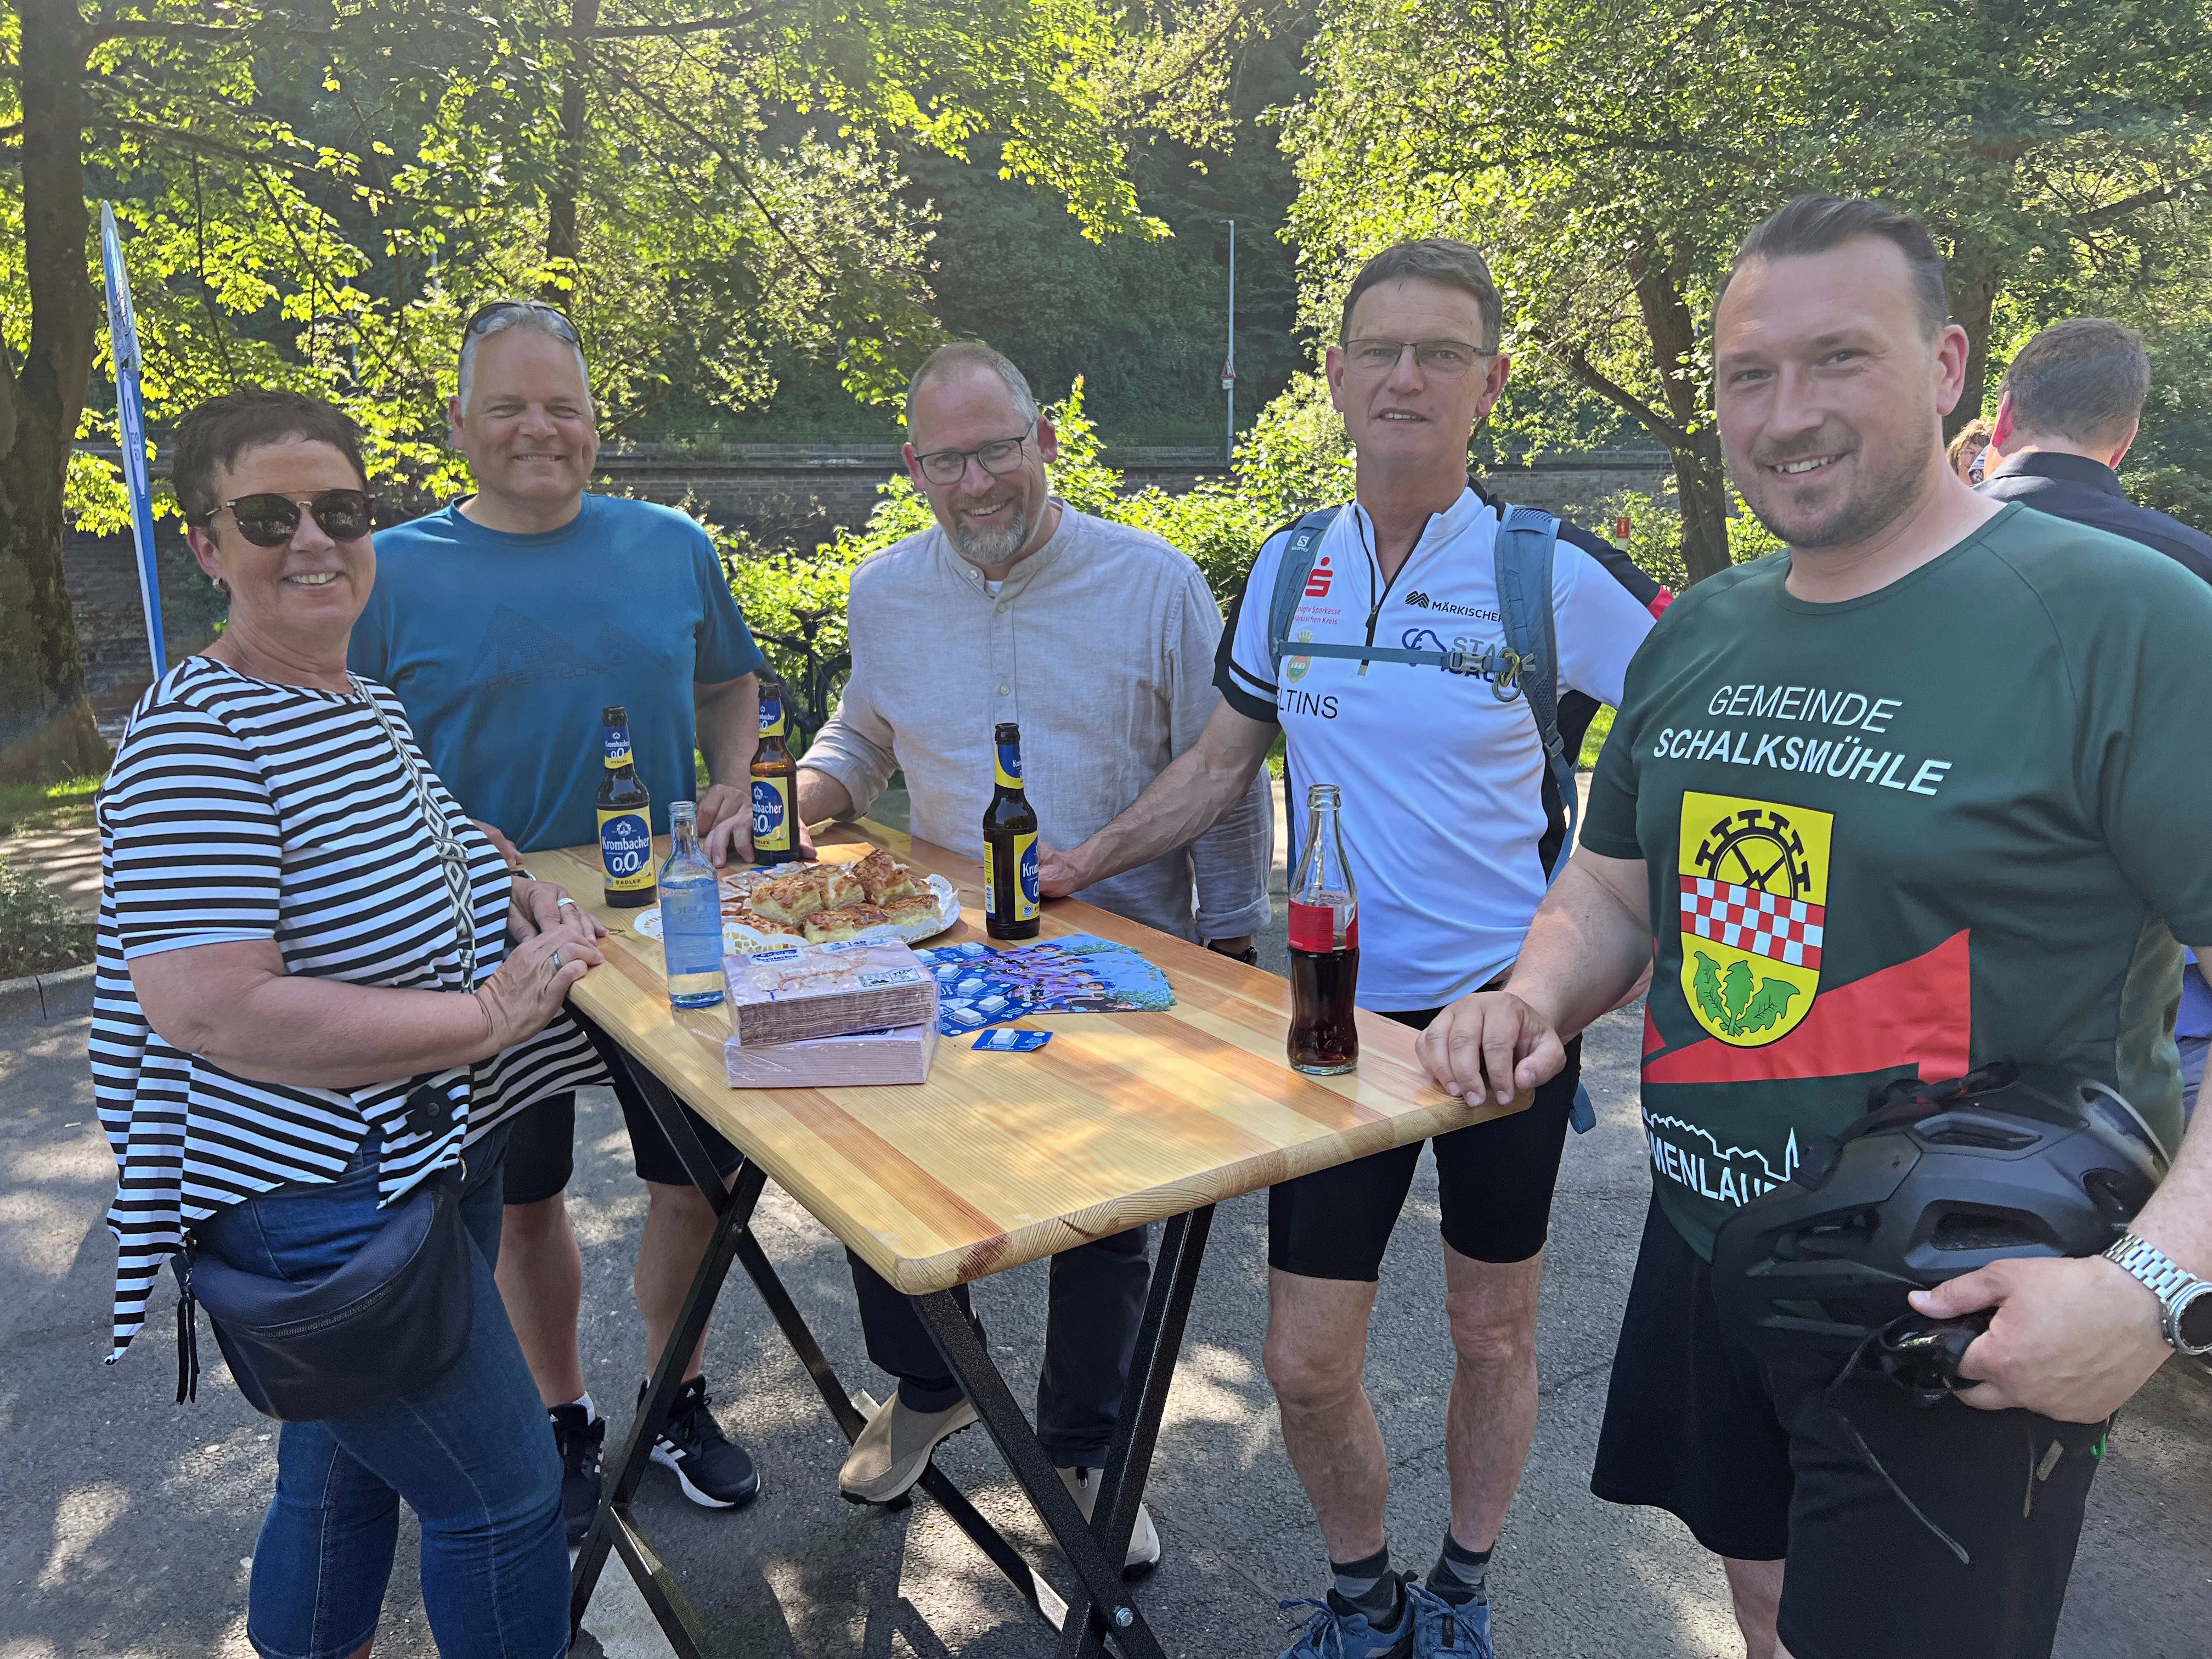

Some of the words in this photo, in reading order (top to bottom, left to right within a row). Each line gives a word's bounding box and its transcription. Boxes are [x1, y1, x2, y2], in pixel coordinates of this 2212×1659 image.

[1312, 606, 1341, 615] Sparkasse
[1277, 687, 1339, 719] LTINS
[1708, 685, 1903, 733] GEMEINDE
[1653, 728, 1953, 796] SCHALKSMÜHLE
[602, 835, 650, 851] Krombacher
